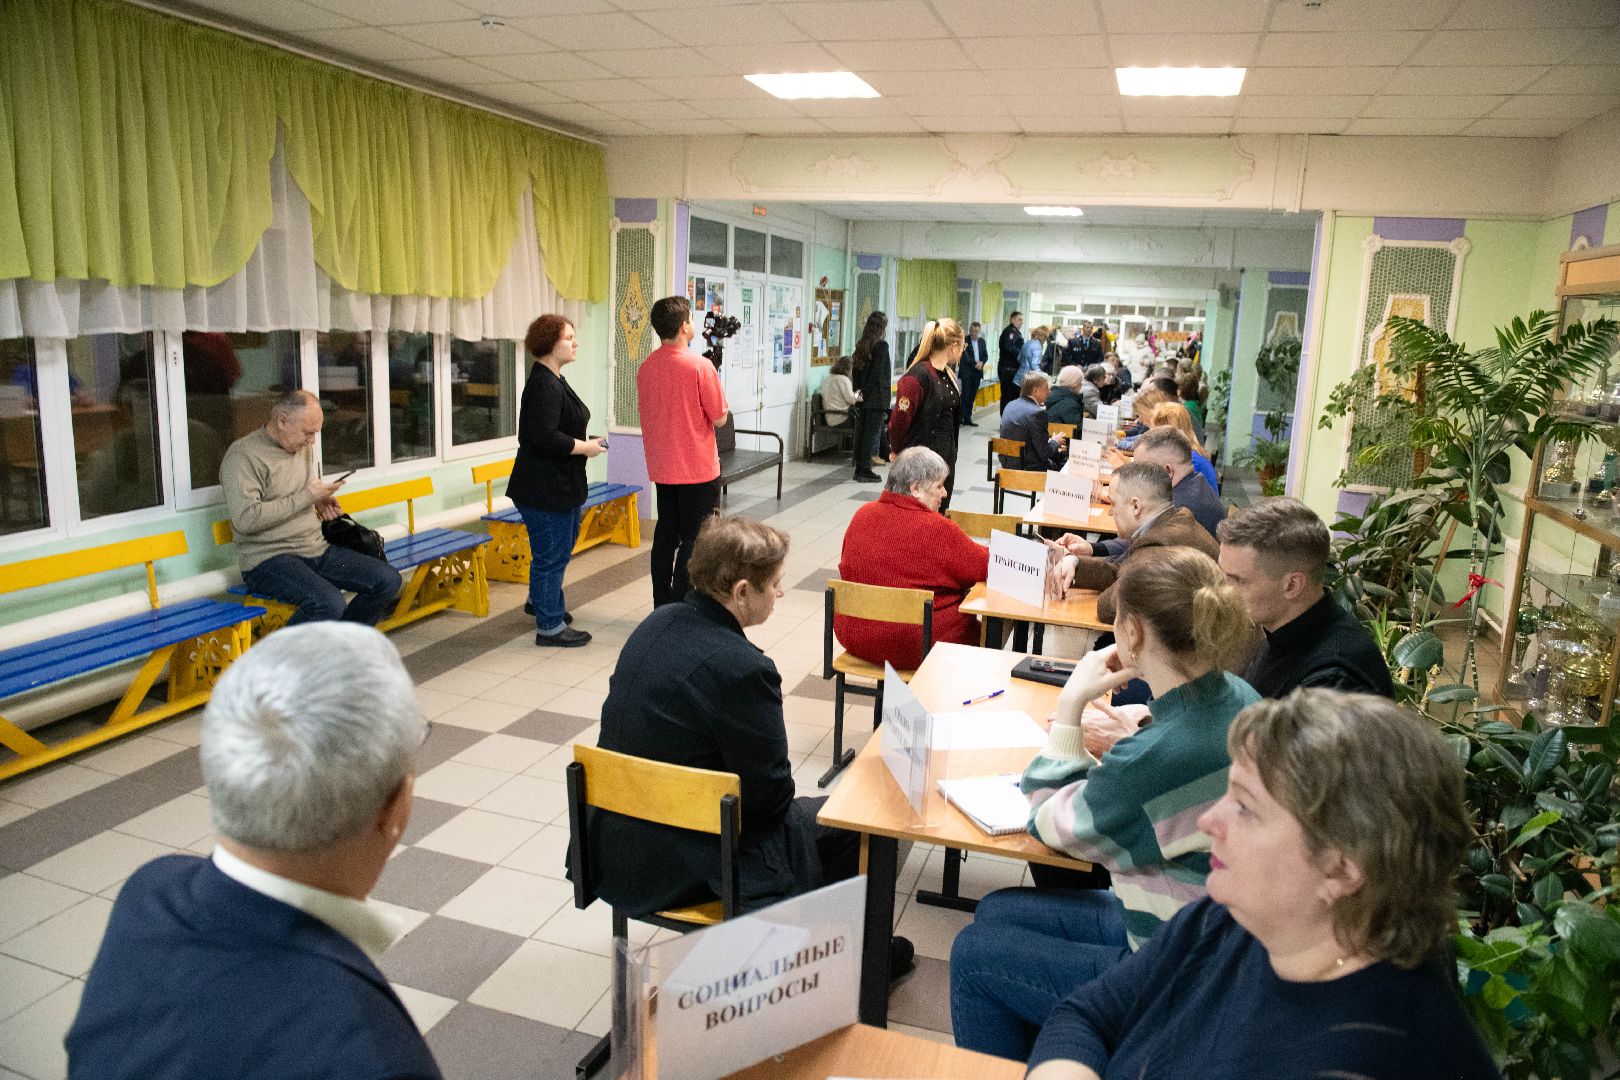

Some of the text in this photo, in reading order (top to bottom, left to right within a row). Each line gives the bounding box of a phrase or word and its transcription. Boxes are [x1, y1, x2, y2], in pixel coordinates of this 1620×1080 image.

[993, 554, 1041, 577] ТРАНСПОРТ
[678, 935, 846, 1010] СОЦИАЛЬНЫЕ
[705, 972, 820, 1030] ВОПРОСЫ
